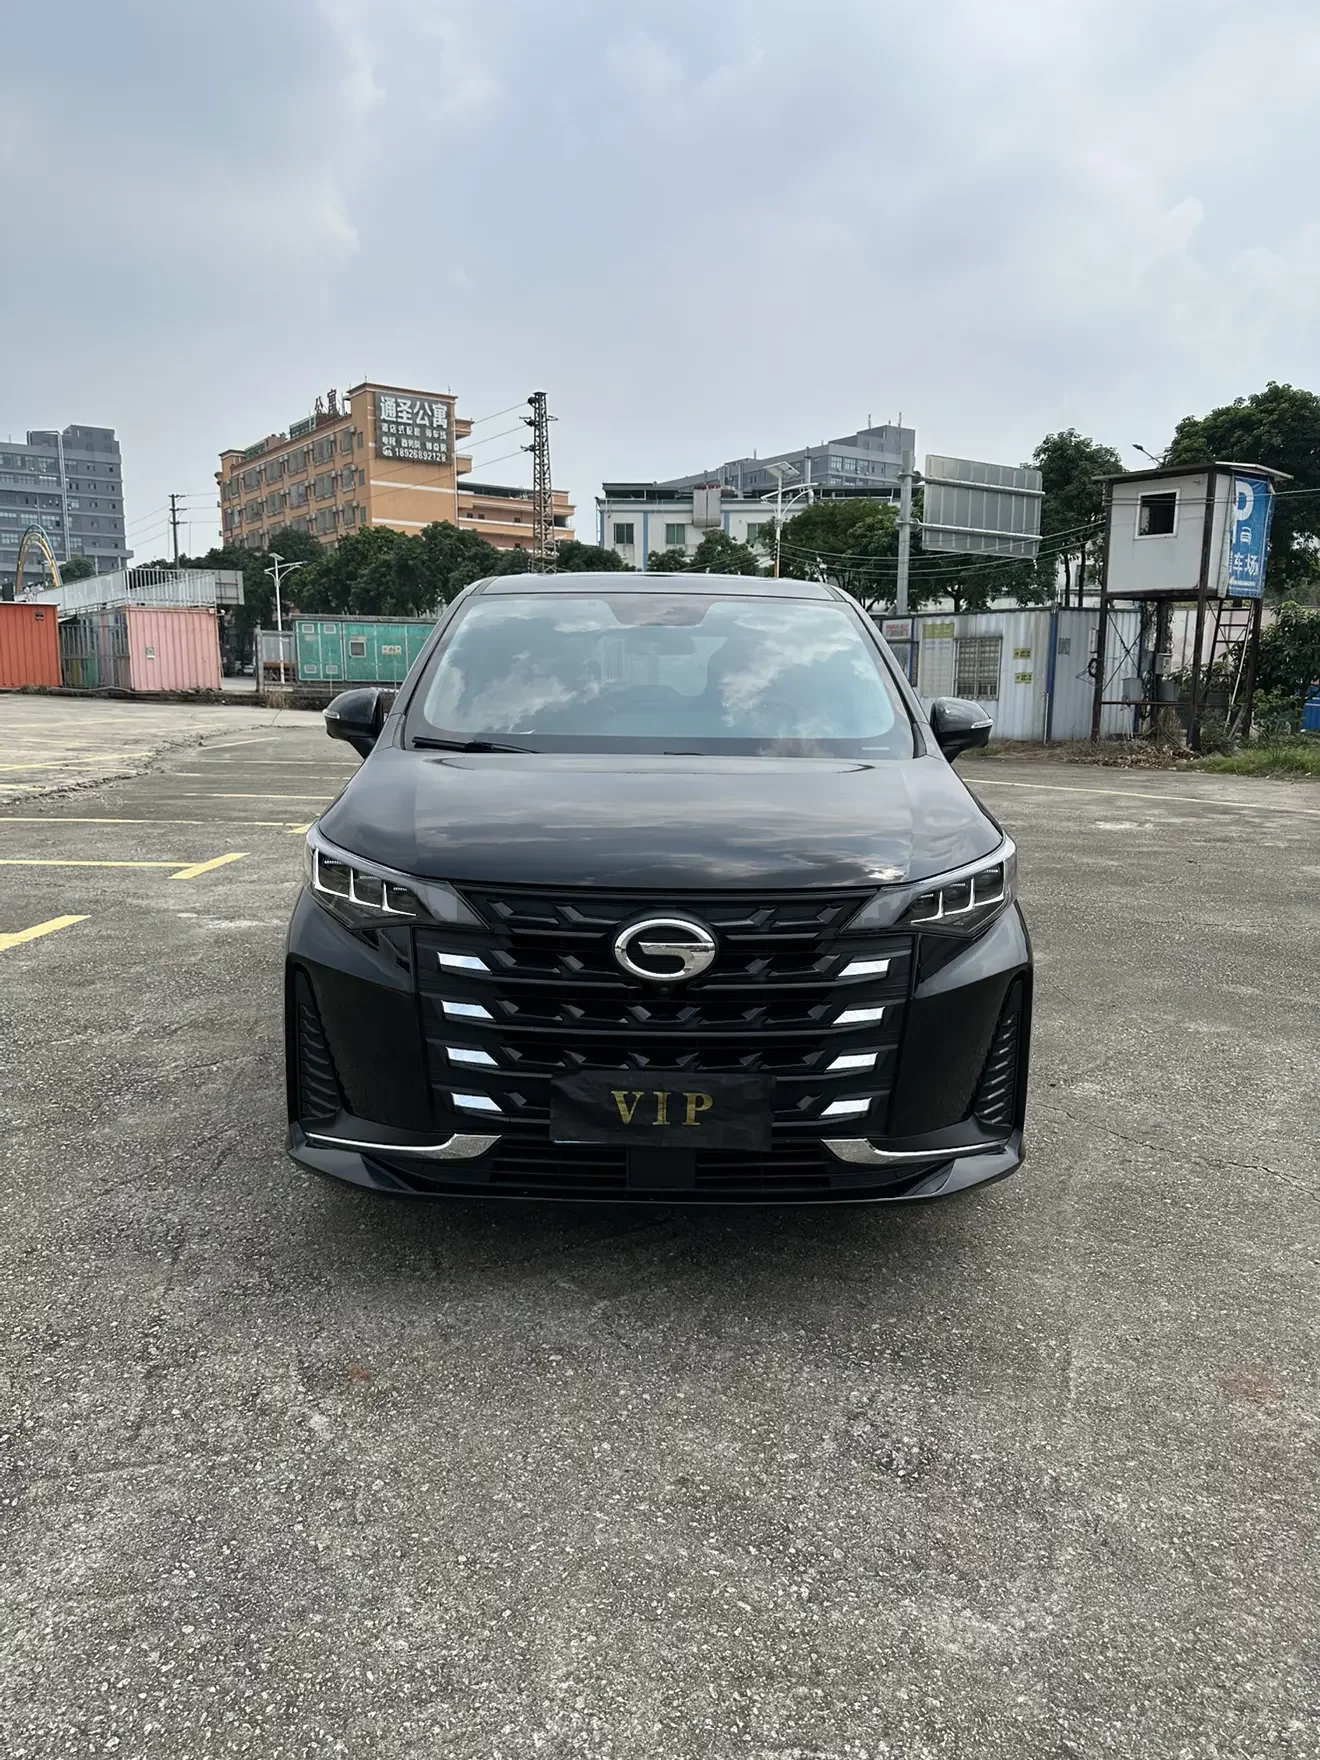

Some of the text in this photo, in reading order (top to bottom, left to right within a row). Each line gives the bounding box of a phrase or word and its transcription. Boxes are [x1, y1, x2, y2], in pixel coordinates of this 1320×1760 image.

[314, 388, 337, 413] 公寓
[380, 396, 448, 429] 通圣公寓
[395, 447, 447, 462] 18926892128
[1232, 480, 1254, 544] P
[610, 1090, 714, 1126] VIP
